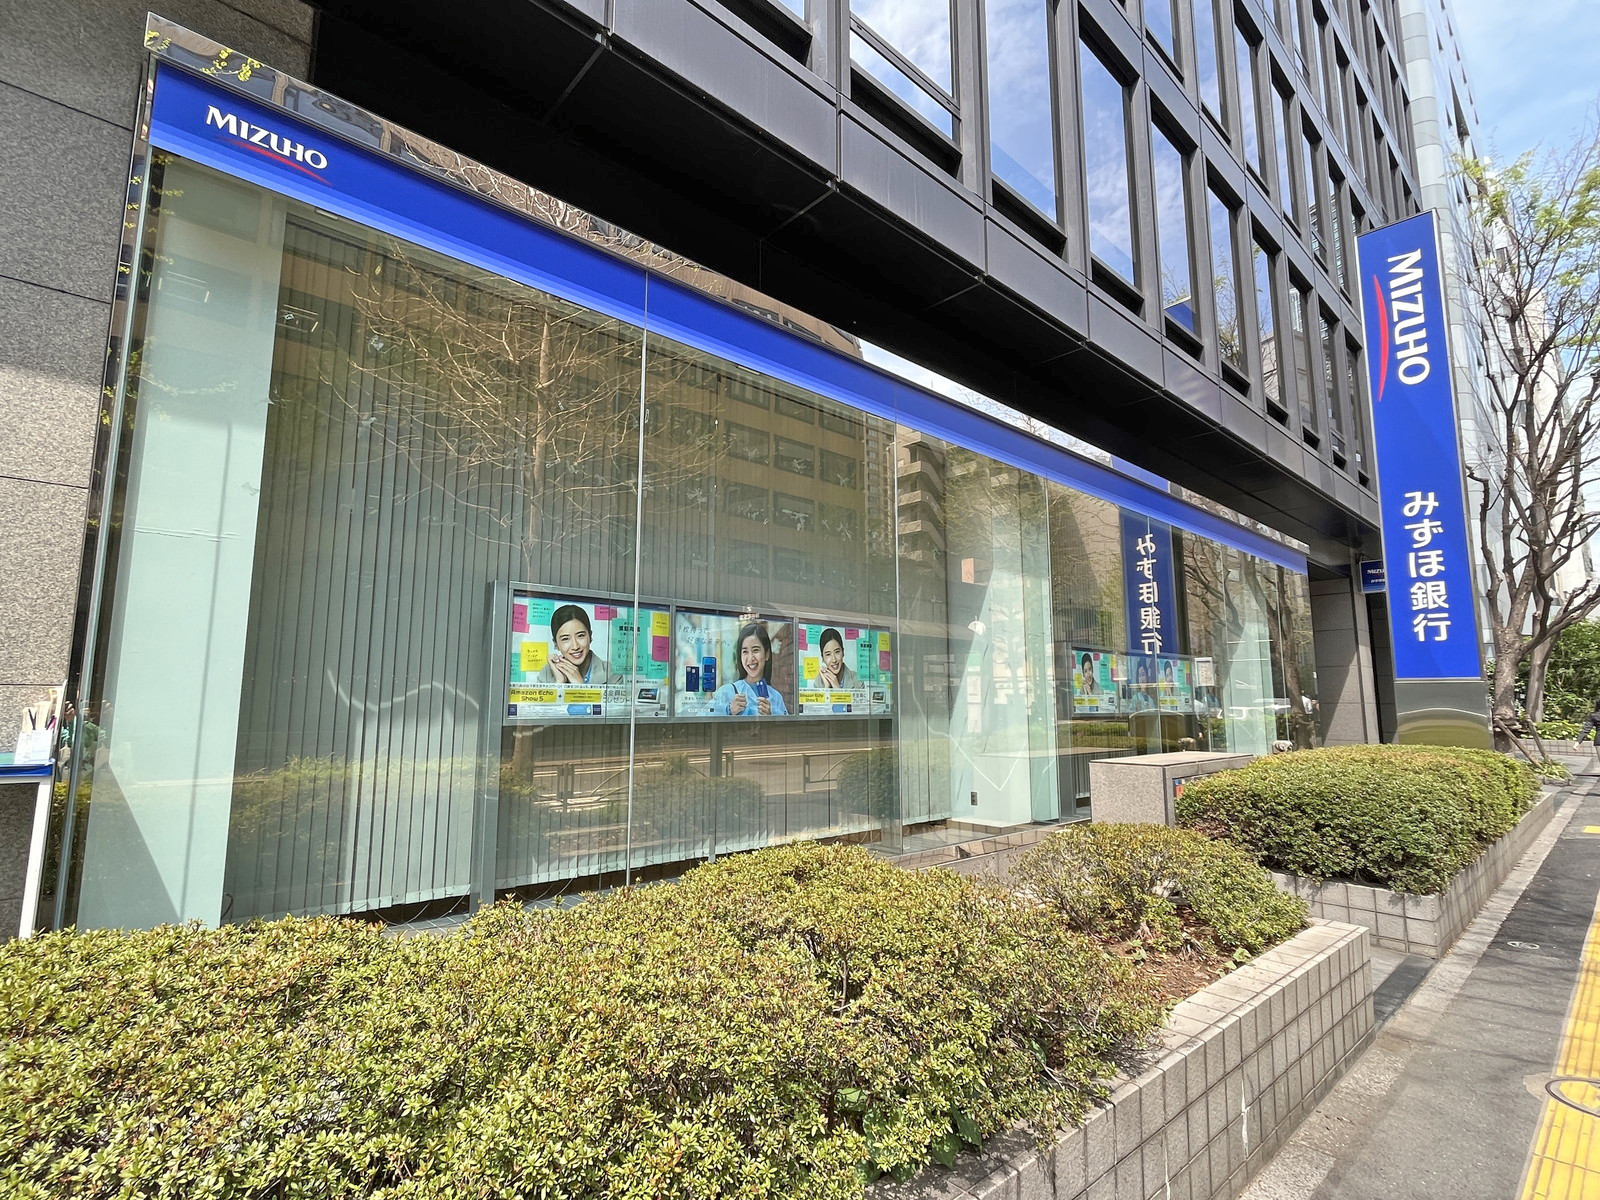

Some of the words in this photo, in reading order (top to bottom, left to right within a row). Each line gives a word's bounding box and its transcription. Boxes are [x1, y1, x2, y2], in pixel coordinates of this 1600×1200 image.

[206, 105, 328, 169] MIZUHO
[1387, 248, 1430, 385] MIZUHO
[1403, 491, 1451, 642] みずほ銀行
